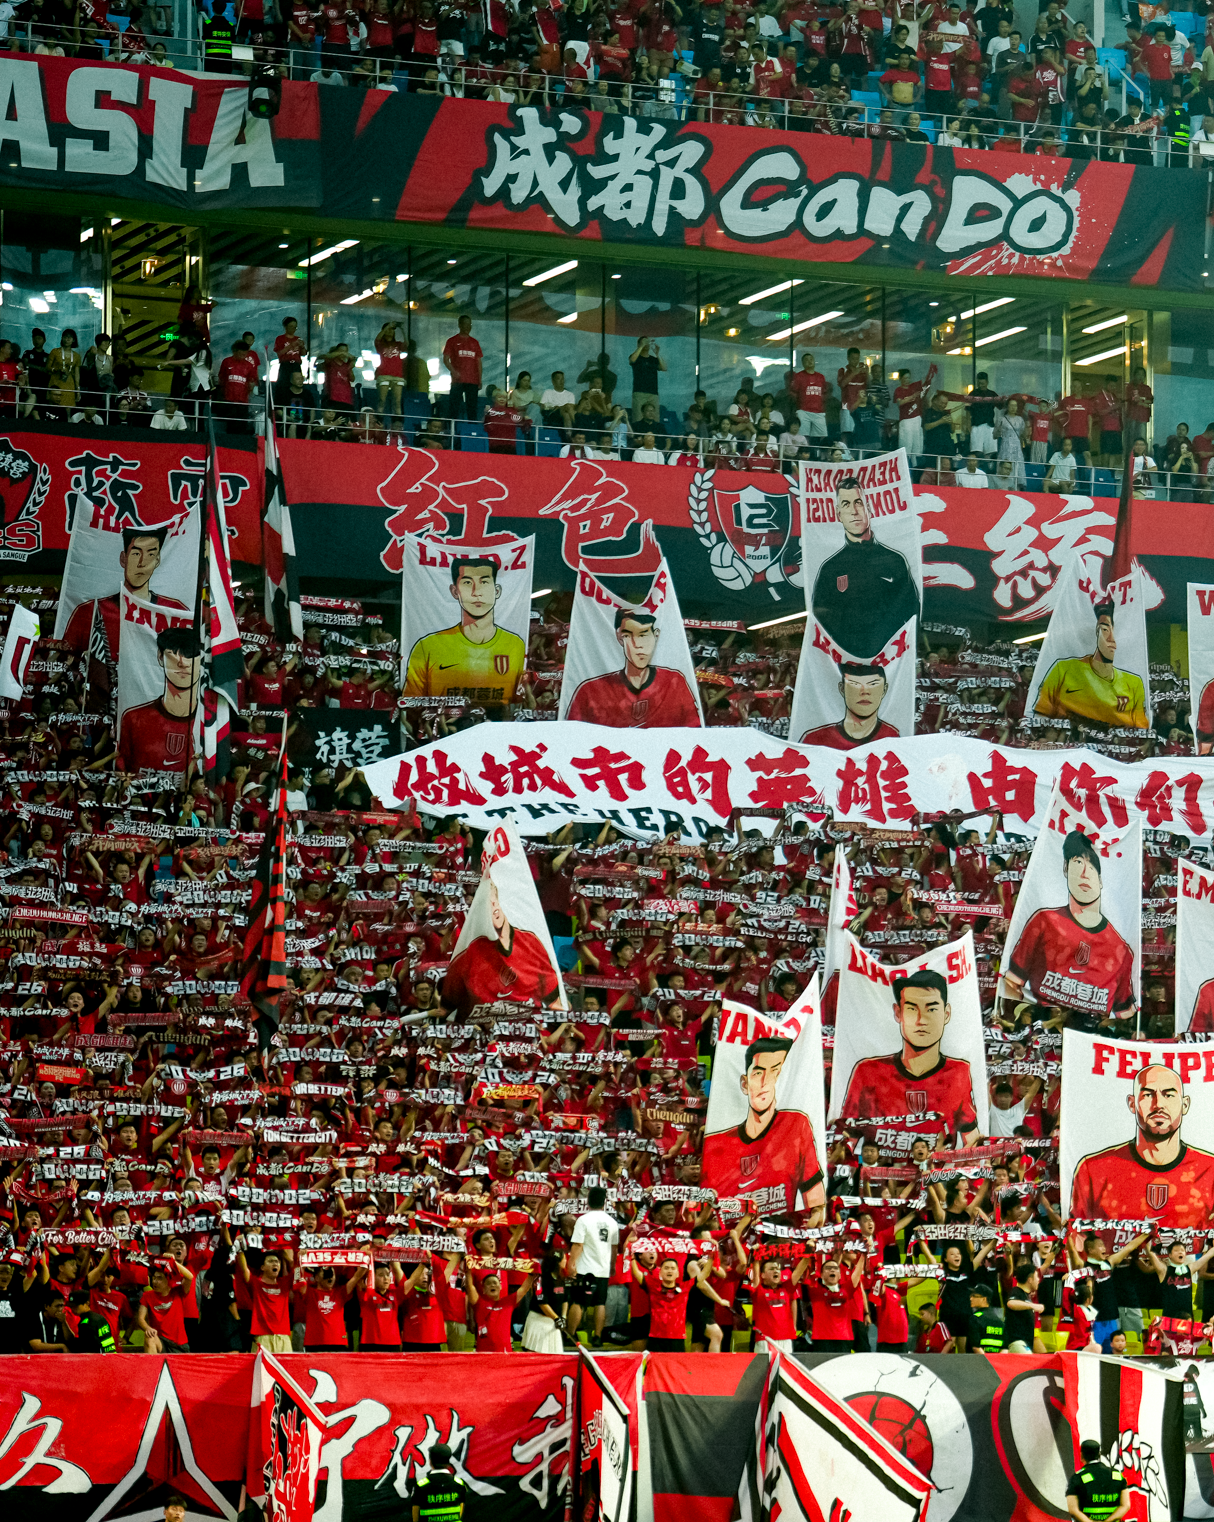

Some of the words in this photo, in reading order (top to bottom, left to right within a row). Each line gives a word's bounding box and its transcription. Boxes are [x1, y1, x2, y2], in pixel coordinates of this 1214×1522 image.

[484, 106, 706, 238] 成都
[746, 553, 770, 561] 2006
[392, 742, 915, 823] 做城市的英雄
[1041, 969, 1110, 1006] 成都蓉城
[1039, 986, 1070, 1007] CHENGDU
[1069, 995, 1108, 1013] RONGCHENG
[161, 1064, 185, 1080] 20
[219, 1063, 245, 1079] 26
[45, 1230, 64, 1245] For
[65, 1230, 97, 1245] Better
[97, 1229, 119, 1247] City
[427, 1492, 460, 1504] 秩序维护
[1091, 1492, 1121, 1504] 秩序维护
